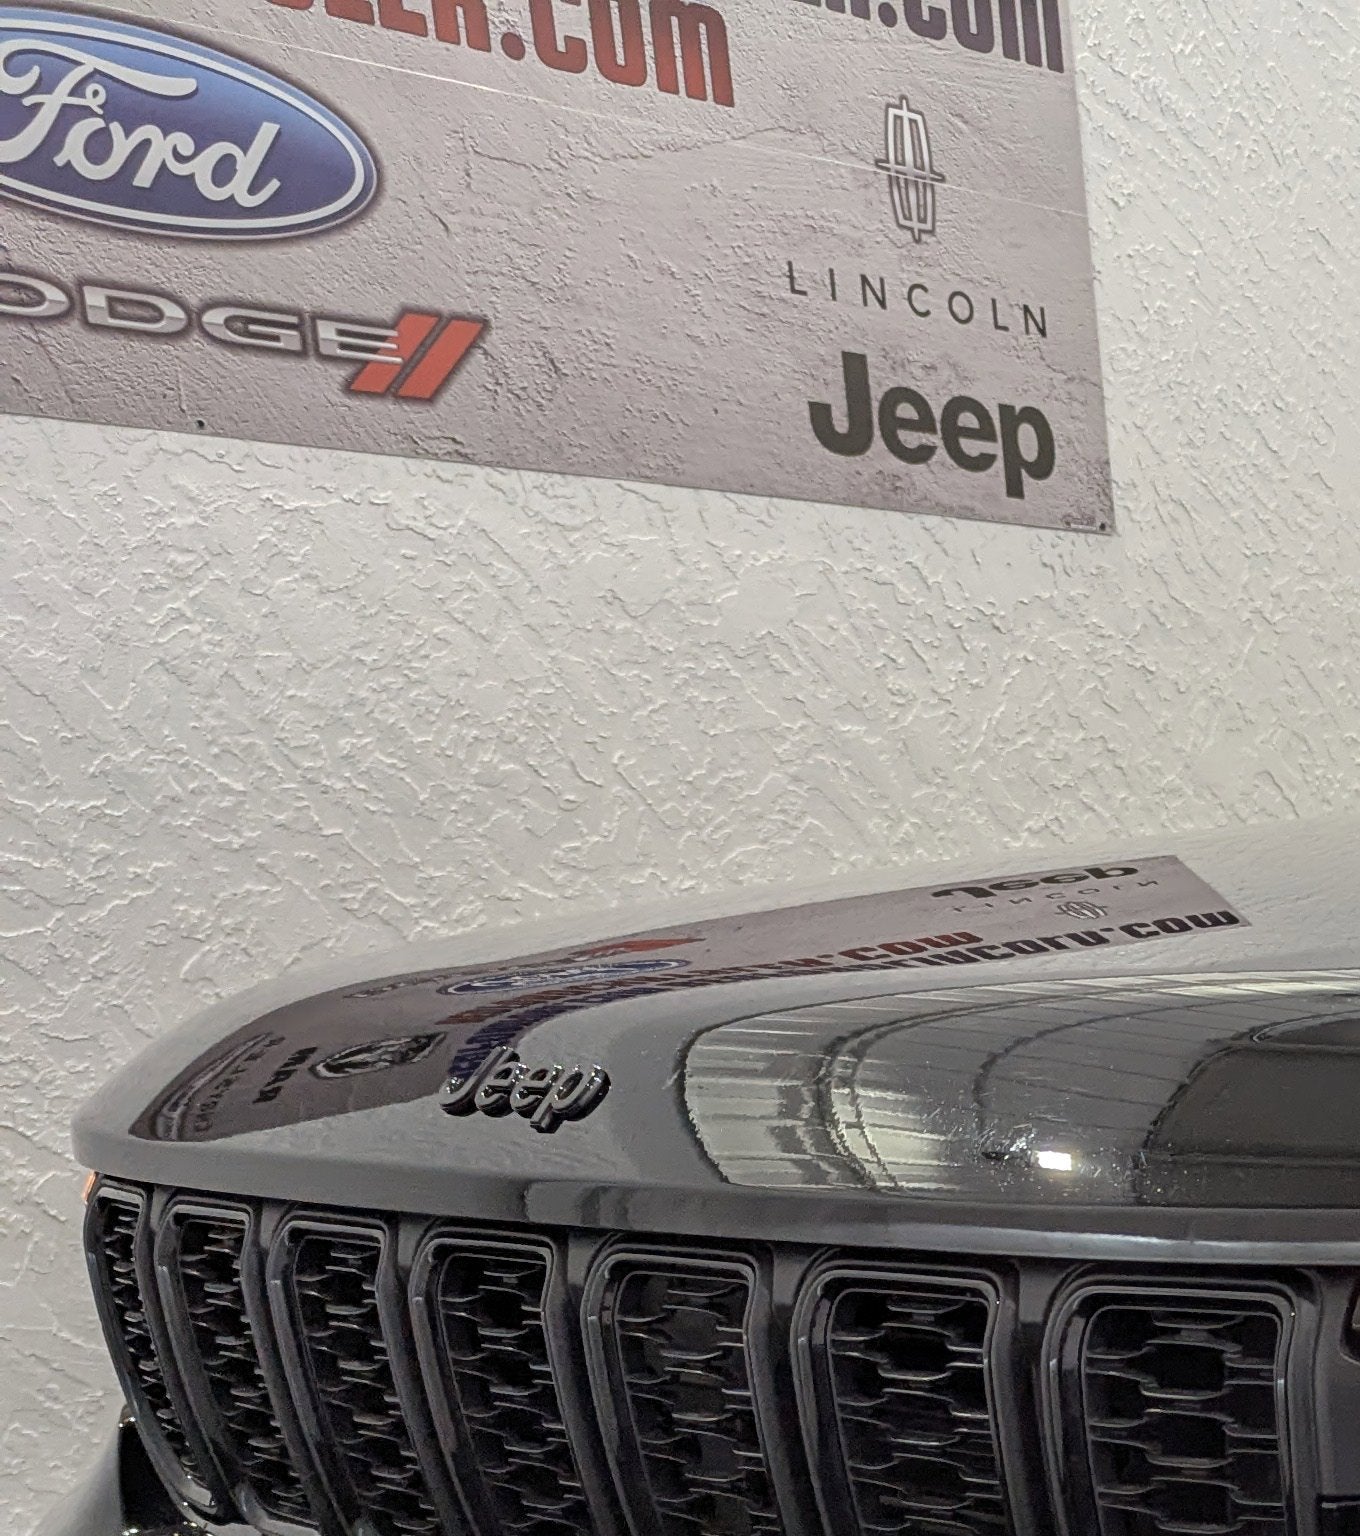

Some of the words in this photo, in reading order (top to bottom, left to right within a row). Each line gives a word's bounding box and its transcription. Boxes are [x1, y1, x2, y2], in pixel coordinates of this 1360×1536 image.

[0, 44, 281, 208] Ford
[787, 260, 1047, 339] LINCOLN
[807, 350, 1056, 500] Jeep
[438, 1045, 613, 1135] Jeep
